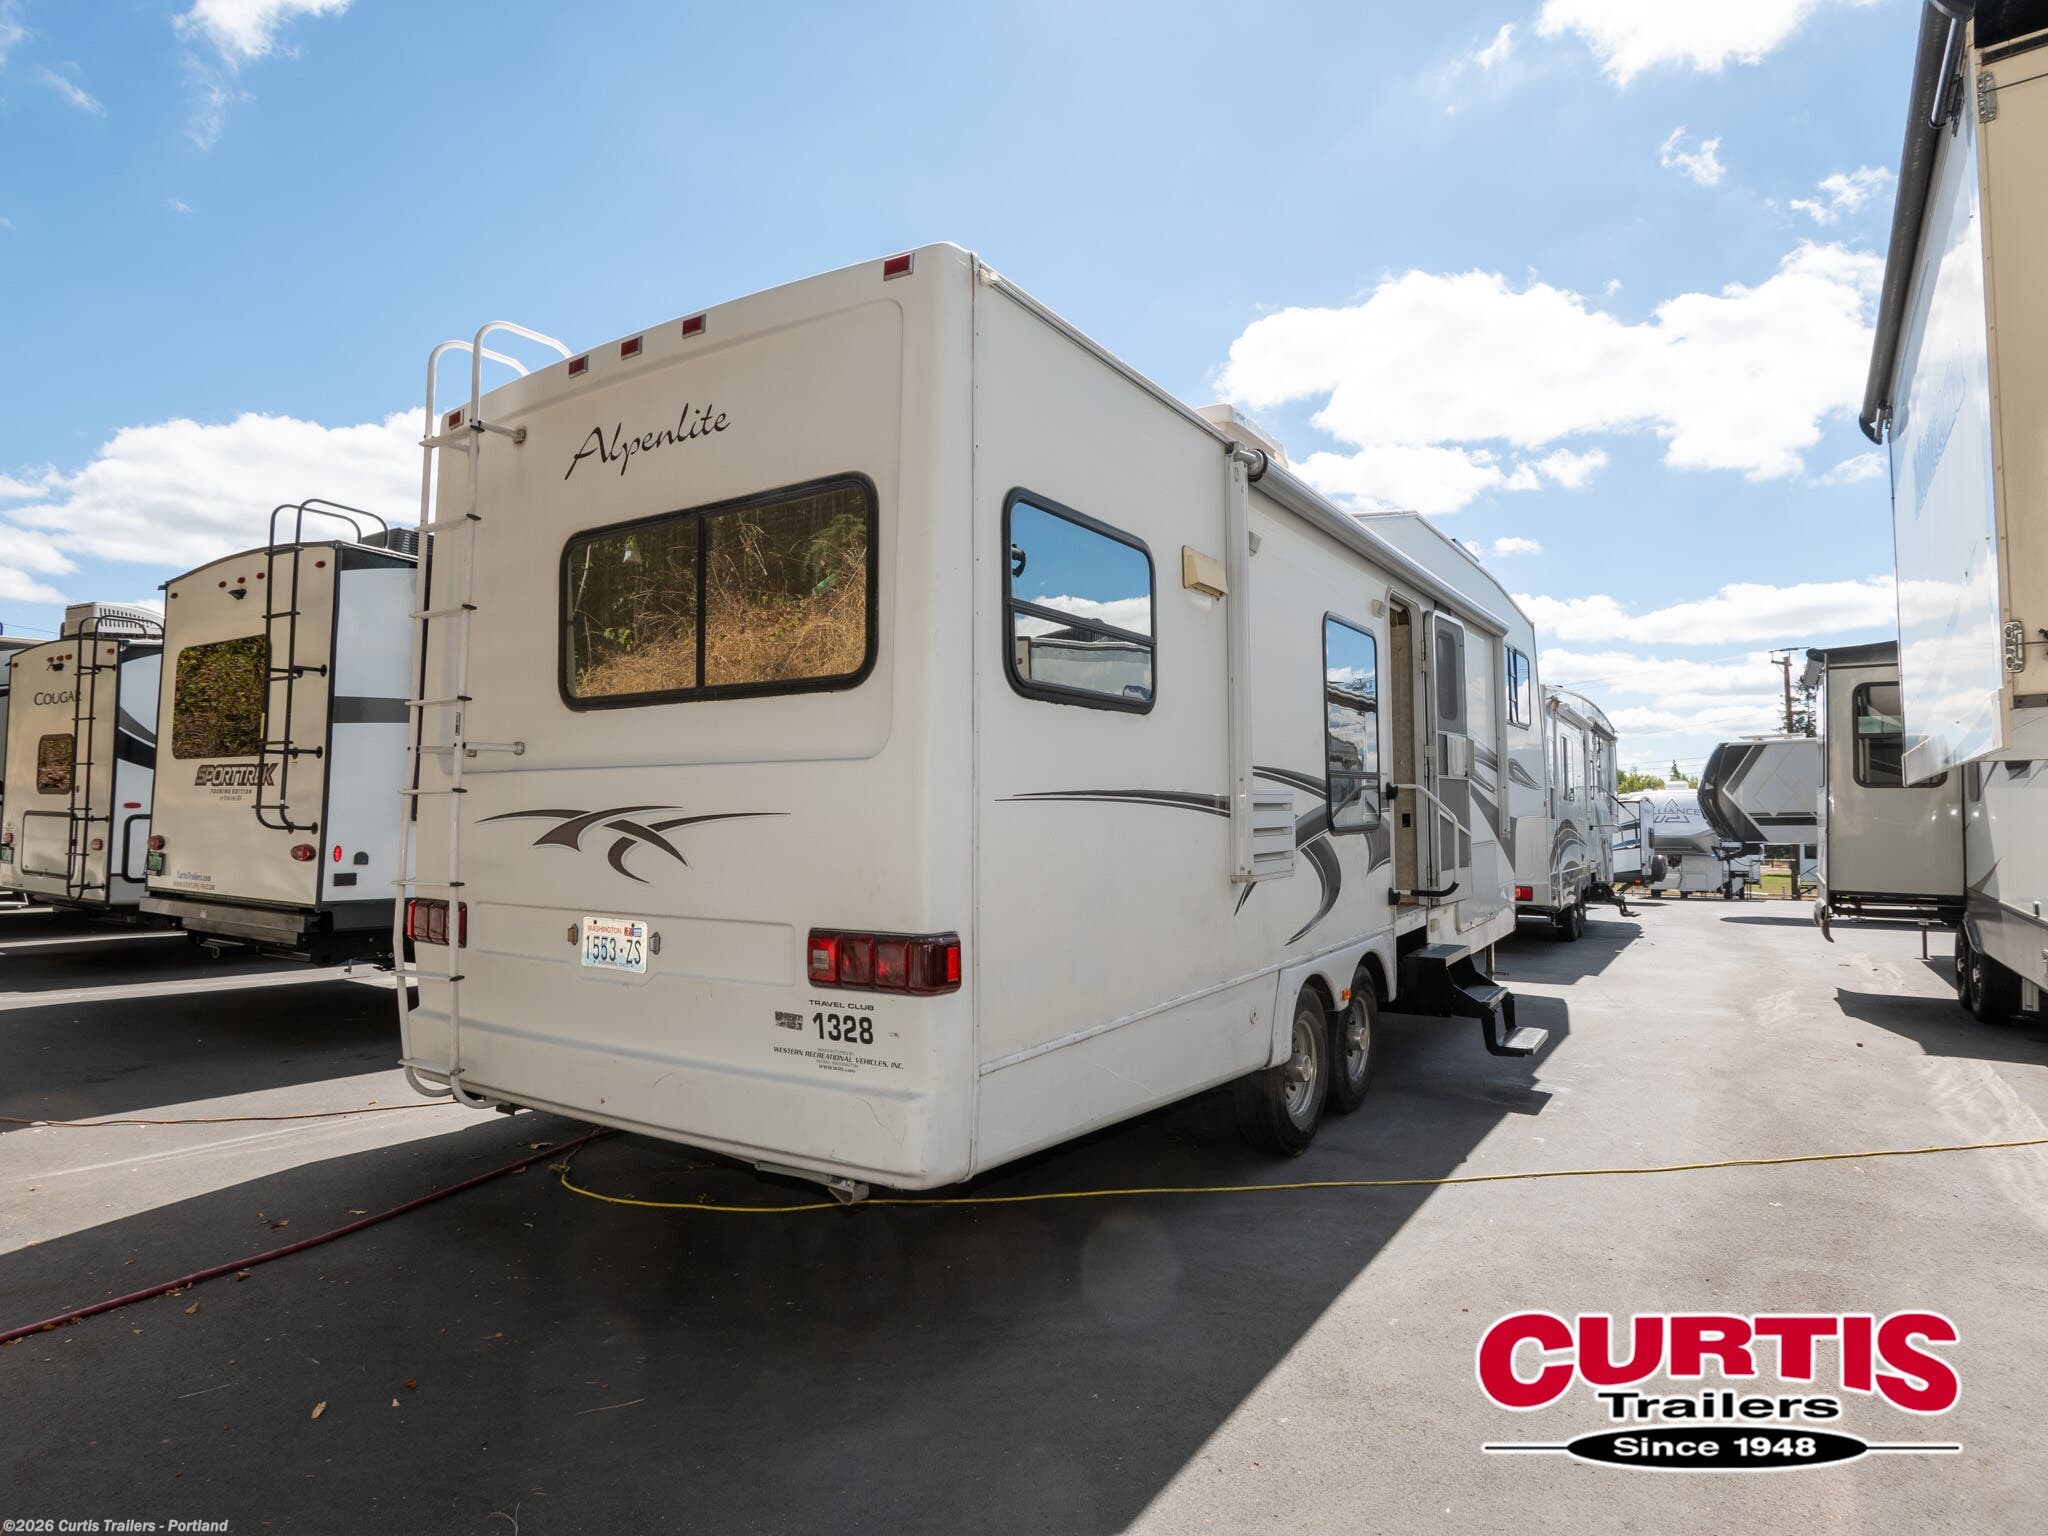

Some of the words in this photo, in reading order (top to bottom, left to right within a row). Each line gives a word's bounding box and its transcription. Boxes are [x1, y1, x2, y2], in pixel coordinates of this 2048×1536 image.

[564, 402, 731, 480] Alpenlite
[34, 690, 81, 706] COUGA
[587, 925, 622, 934] WASHINGTON
[808, 999, 845, 1009] TRAVEL
[847, 1003, 875, 1011] CLUB
[812, 1012, 874, 1045] 1328
[773, 1046, 804, 1057] WESTERN
[804, 1050, 853, 1063] RECREATIONAL
